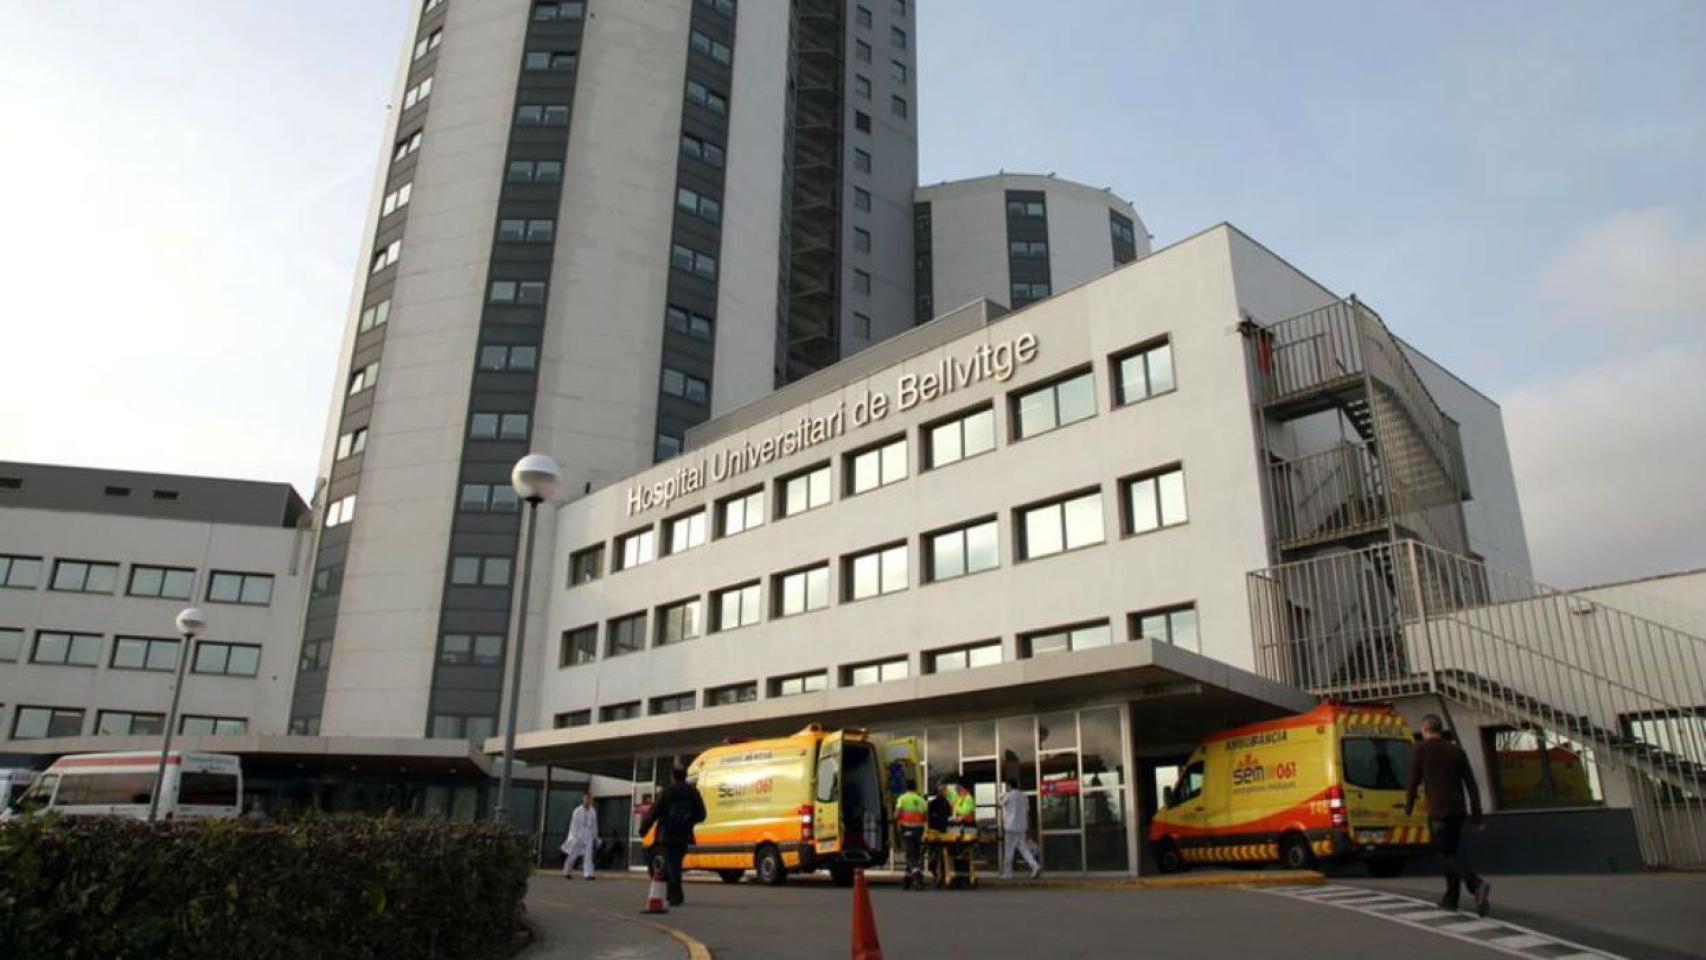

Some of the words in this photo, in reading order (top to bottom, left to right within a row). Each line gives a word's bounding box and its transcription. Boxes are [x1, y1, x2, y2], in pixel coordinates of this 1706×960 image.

[627, 460, 707, 516] Hospital
[712, 402, 846, 481] Universitari
[853, 389, 891, 428] de
[896, 332, 1040, 412] Bellvitge
[1277, 761, 1296, 779] 061
